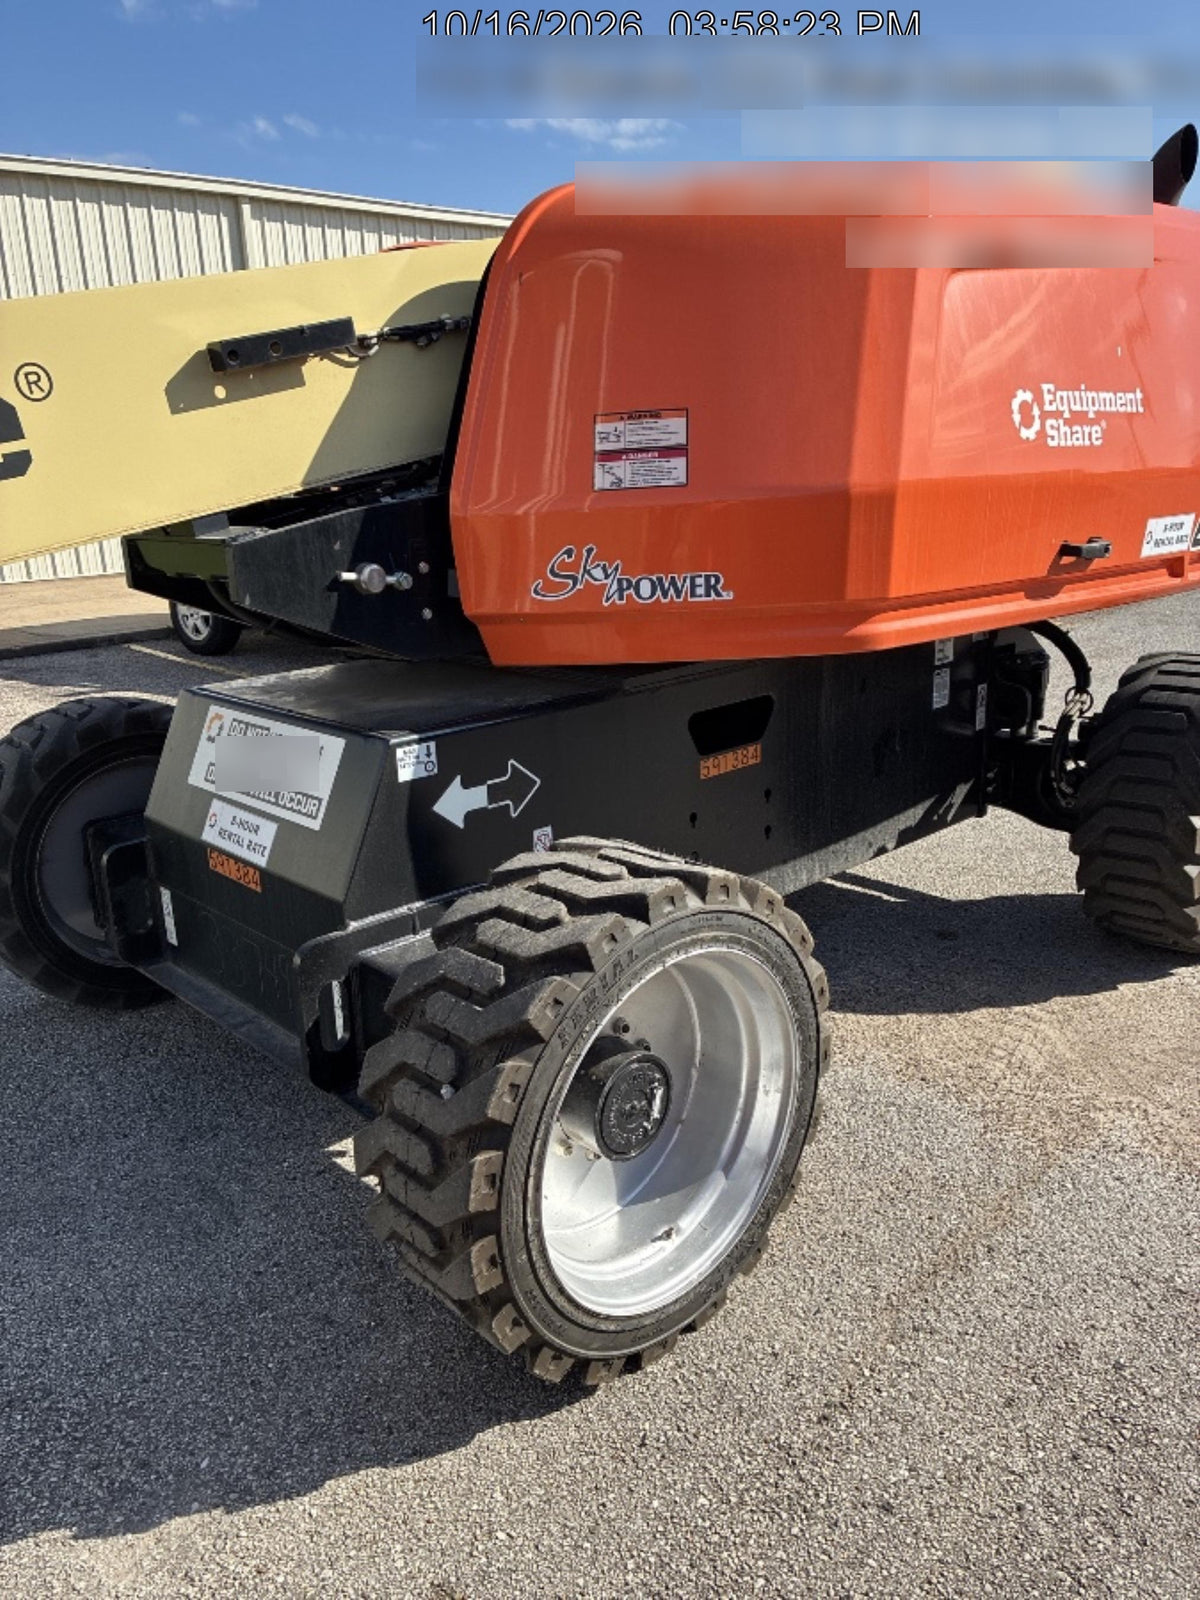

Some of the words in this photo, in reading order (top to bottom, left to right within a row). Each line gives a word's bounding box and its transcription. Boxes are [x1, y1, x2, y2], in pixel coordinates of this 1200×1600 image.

[1041, 383, 1144, 418] Equipment
[701, 743, 760, 779] 591384
[278, 791, 318, 817] OCCUR
[218, 827, 244, 849] RENTAL
[246, 839, 268, 857] RATE
